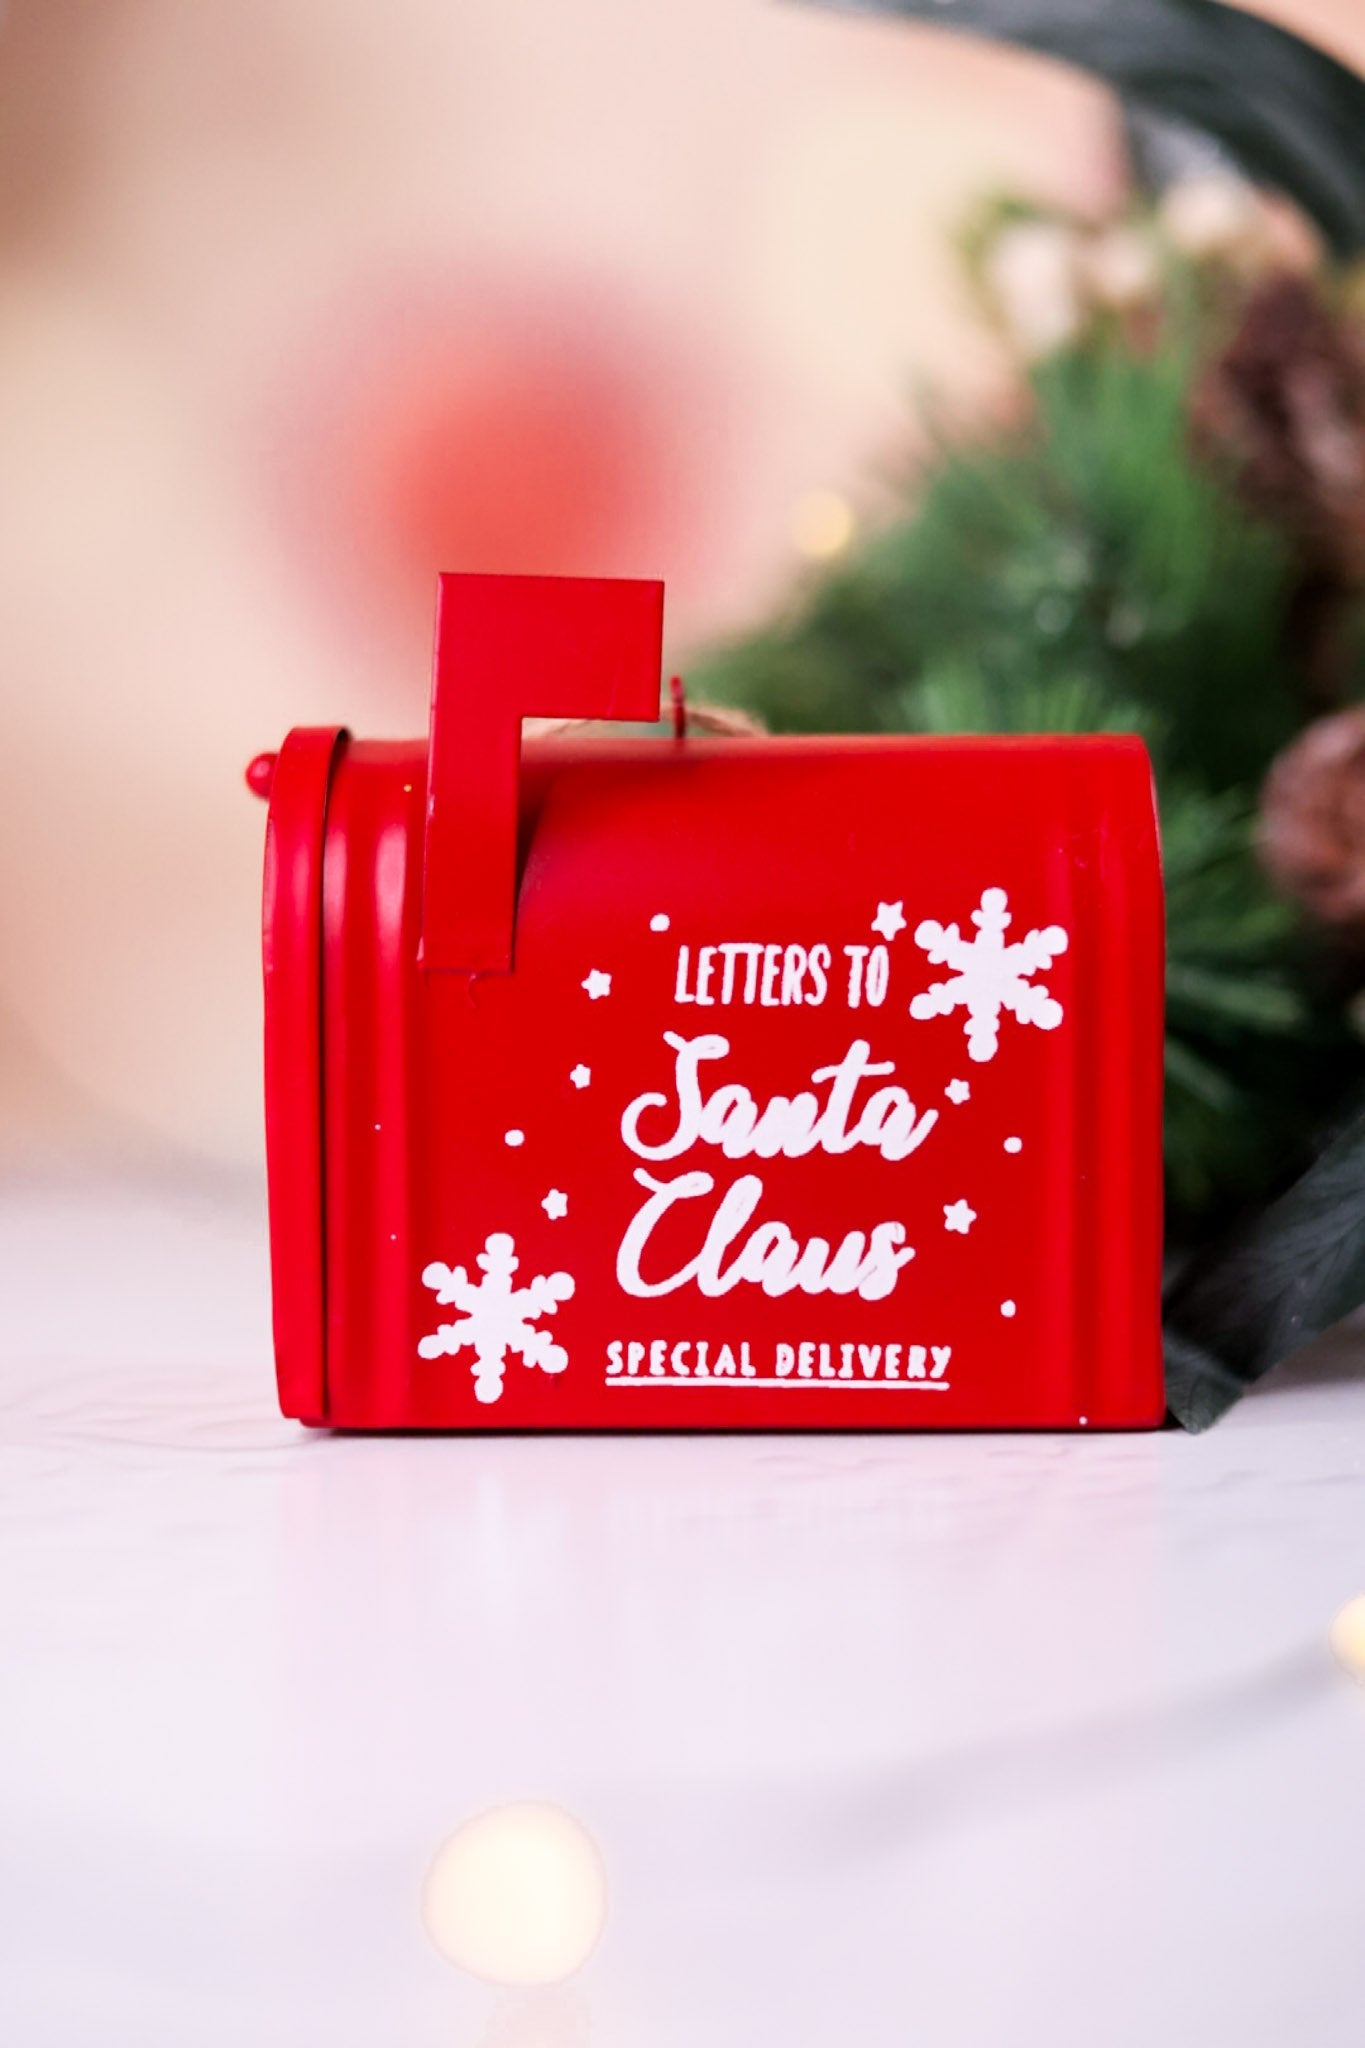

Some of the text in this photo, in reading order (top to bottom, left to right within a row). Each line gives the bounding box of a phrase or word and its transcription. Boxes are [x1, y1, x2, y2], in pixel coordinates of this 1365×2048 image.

[675, 943, 890, 1008] LETTERS TO
[621, 1031, 939, 1161] Santa
[616, 1168, 916, 1301] Claus
[606, 1340, 952, 1379] SPECIAL DELIVERY
